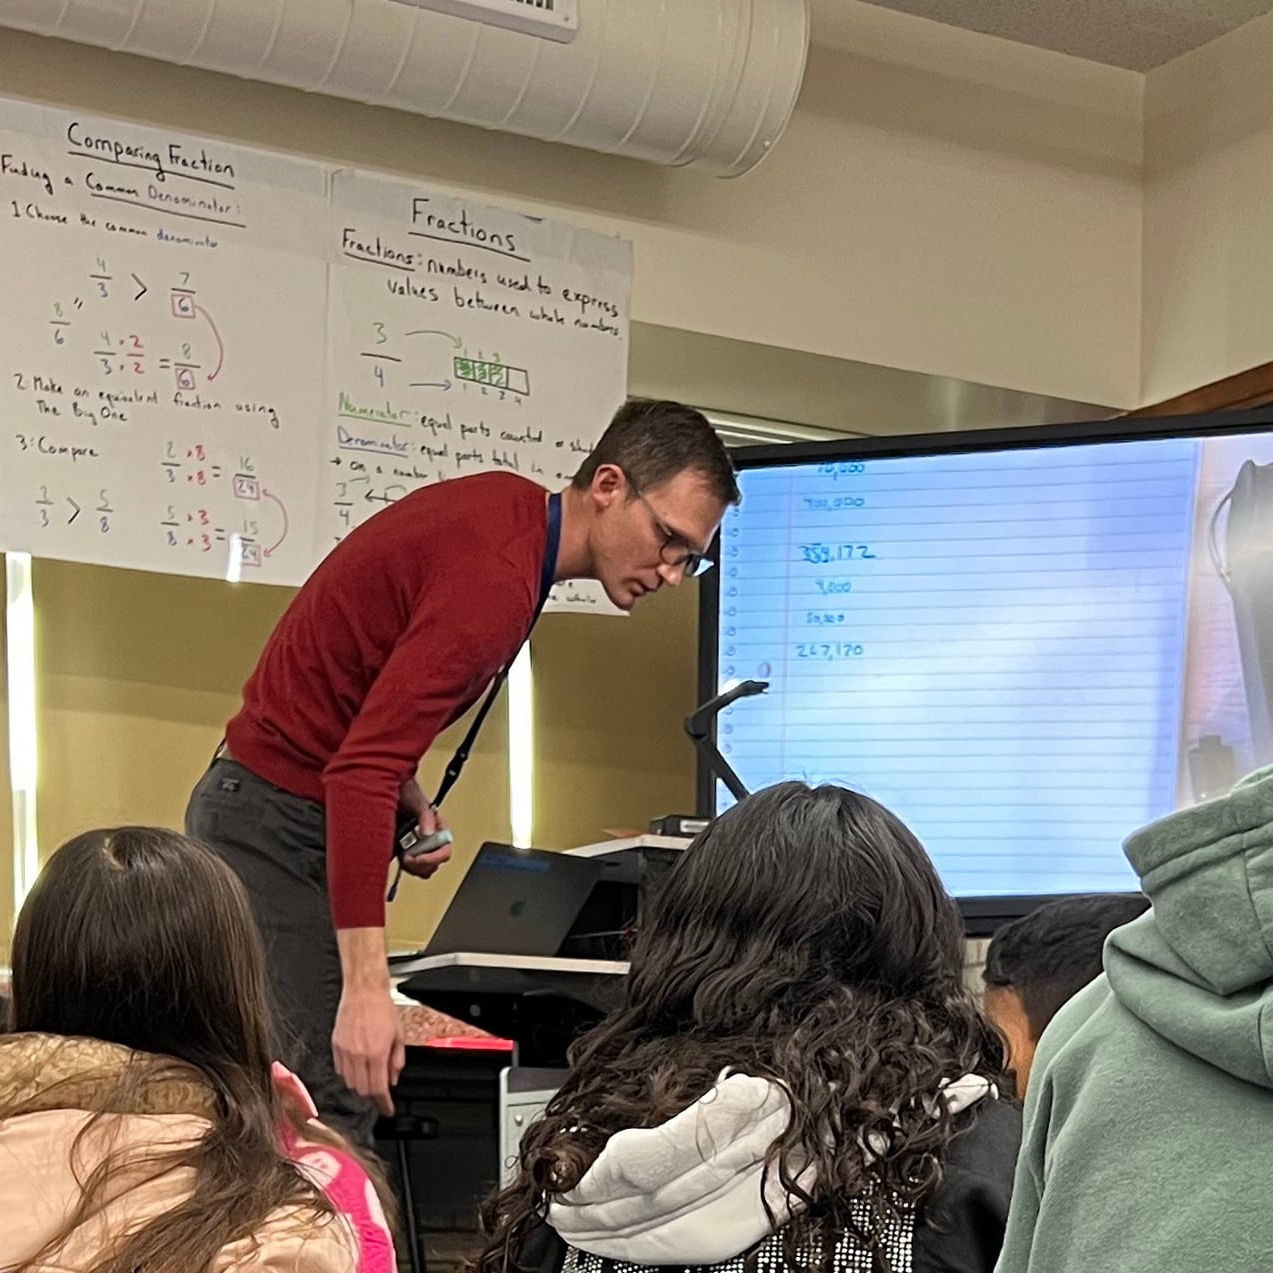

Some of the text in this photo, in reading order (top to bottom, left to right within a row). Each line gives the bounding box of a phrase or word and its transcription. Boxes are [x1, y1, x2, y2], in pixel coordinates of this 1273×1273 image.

[67, 122, 235, 182] Comparing Fraction
[412, 197, 516, 253] Fractions
[387, 277, 439, 302] values
[454, 287, 521, 318] between
[426, 258, 487, 285] numbers
[497, 274, 531, 292] used
[537, 275, 552, 295] to
[563, 288, 619, 319] express
[36, 399, 61, 417] The
[72, 401, 98, 426] Big
[234, 403, 280, 429] using
